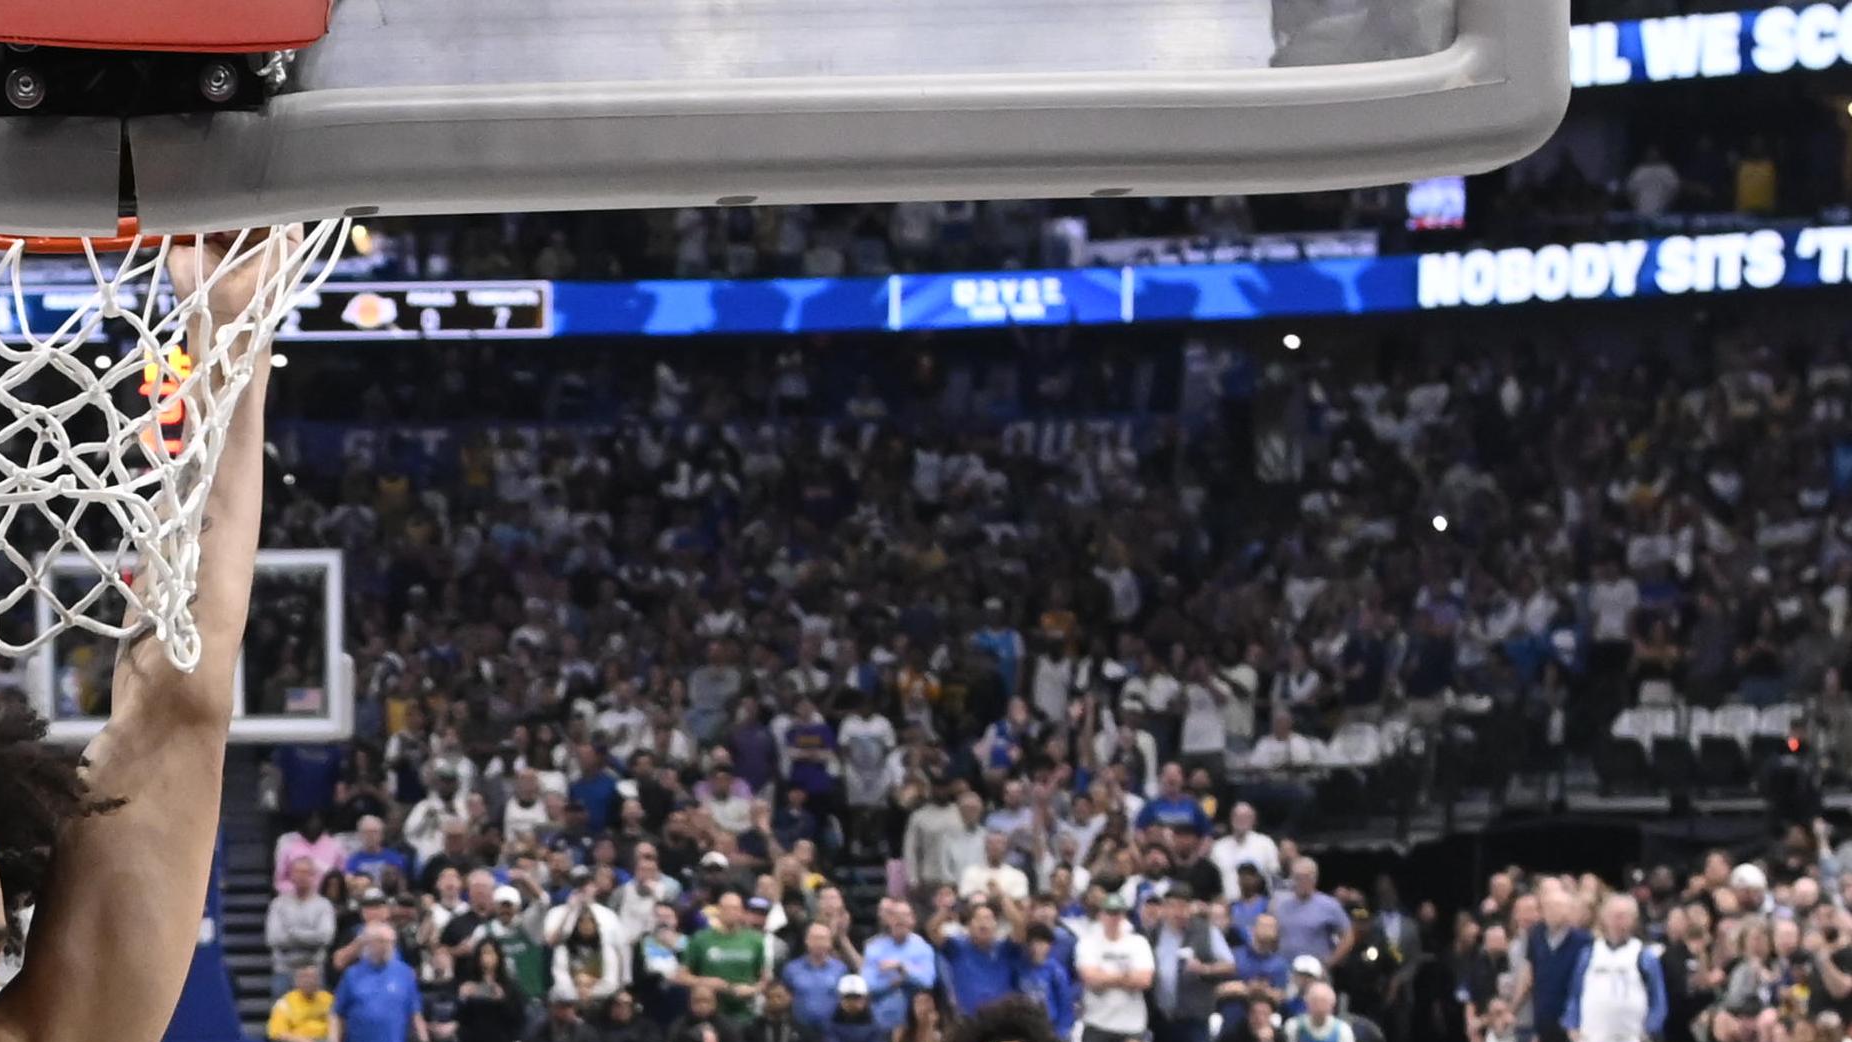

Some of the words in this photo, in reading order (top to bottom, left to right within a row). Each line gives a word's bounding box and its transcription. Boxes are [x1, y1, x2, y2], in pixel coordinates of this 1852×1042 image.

[1640, 13, 1742, 82] WE
[1752, 2, 1852, 74] SC
[1416, 237, 1649, 310] NOBODY
[1654, 229, 1787, 295] SITS
[1794, 223, 1852, 285] 'T
